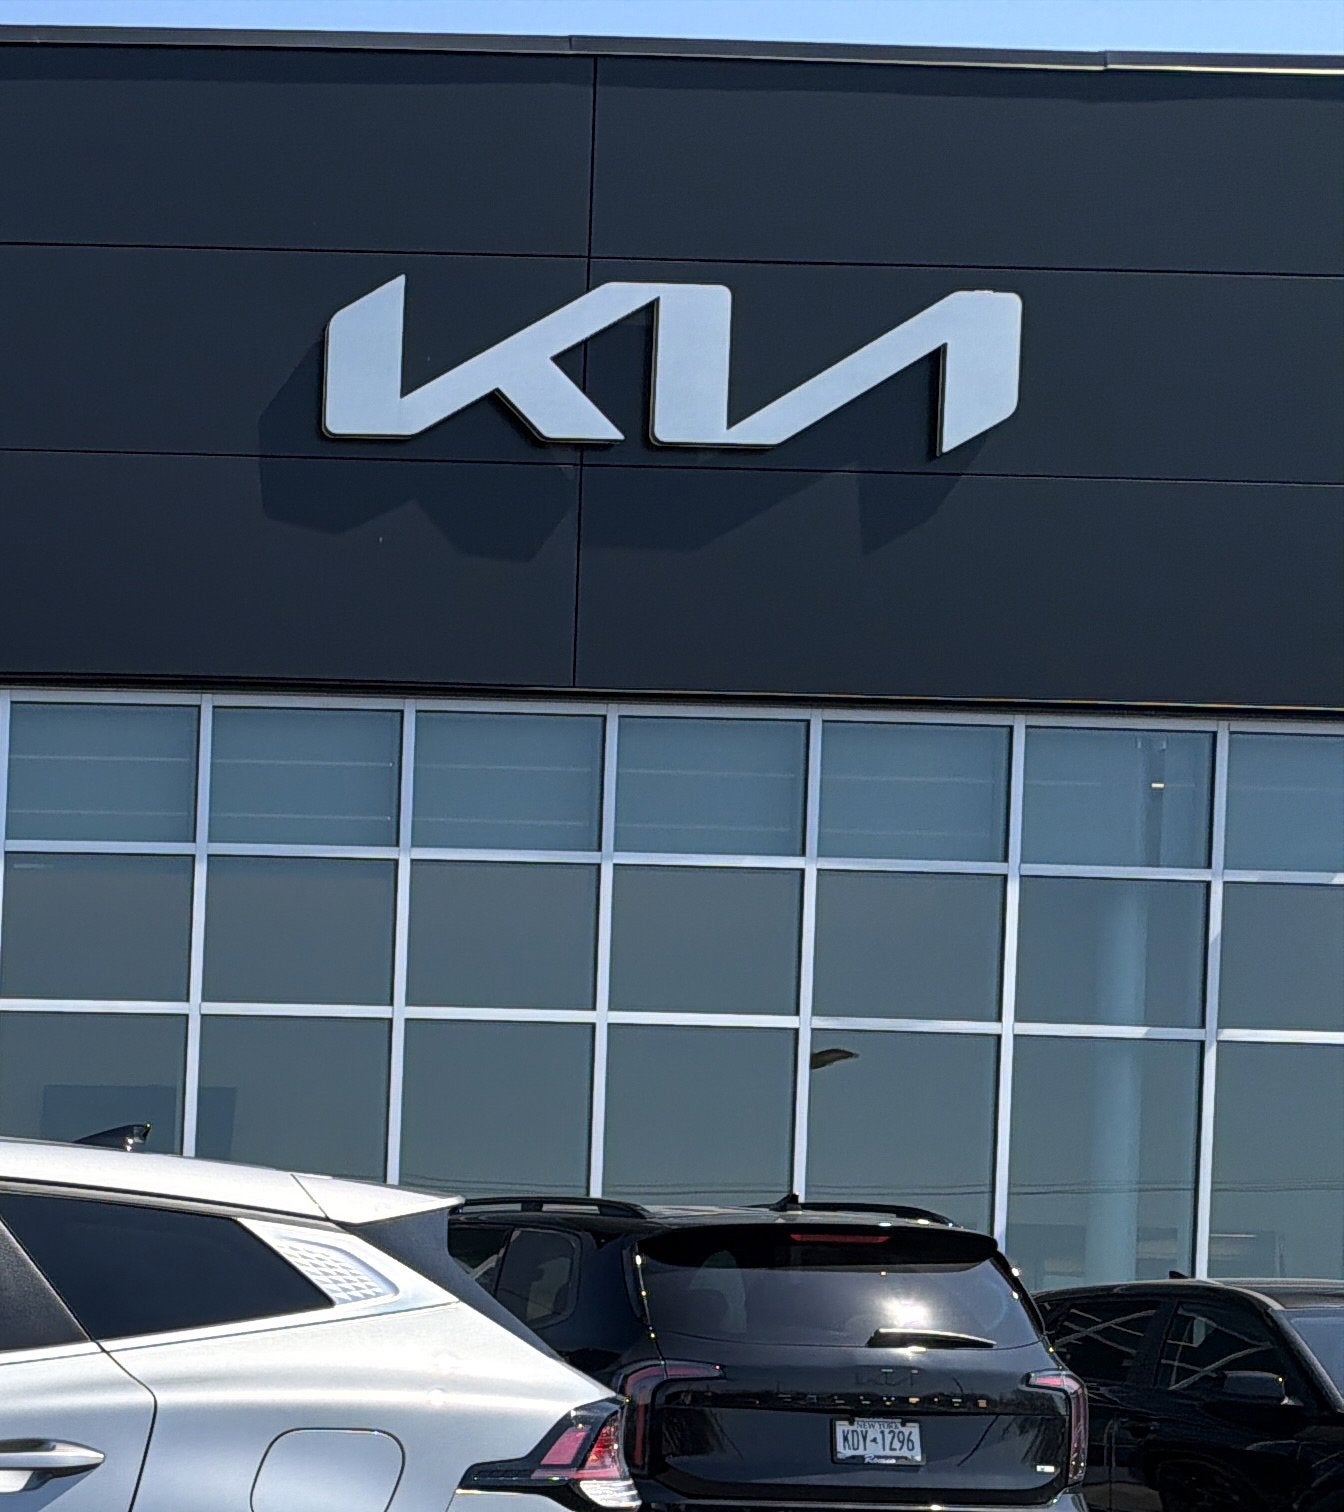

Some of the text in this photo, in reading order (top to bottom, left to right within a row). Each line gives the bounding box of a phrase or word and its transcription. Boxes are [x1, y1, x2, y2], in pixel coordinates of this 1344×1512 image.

[324, 274, 1023, 455] KIA
[857, 1421, 900, 1430] NEW YORK
[879, 1429, 915, 1452] 1296
